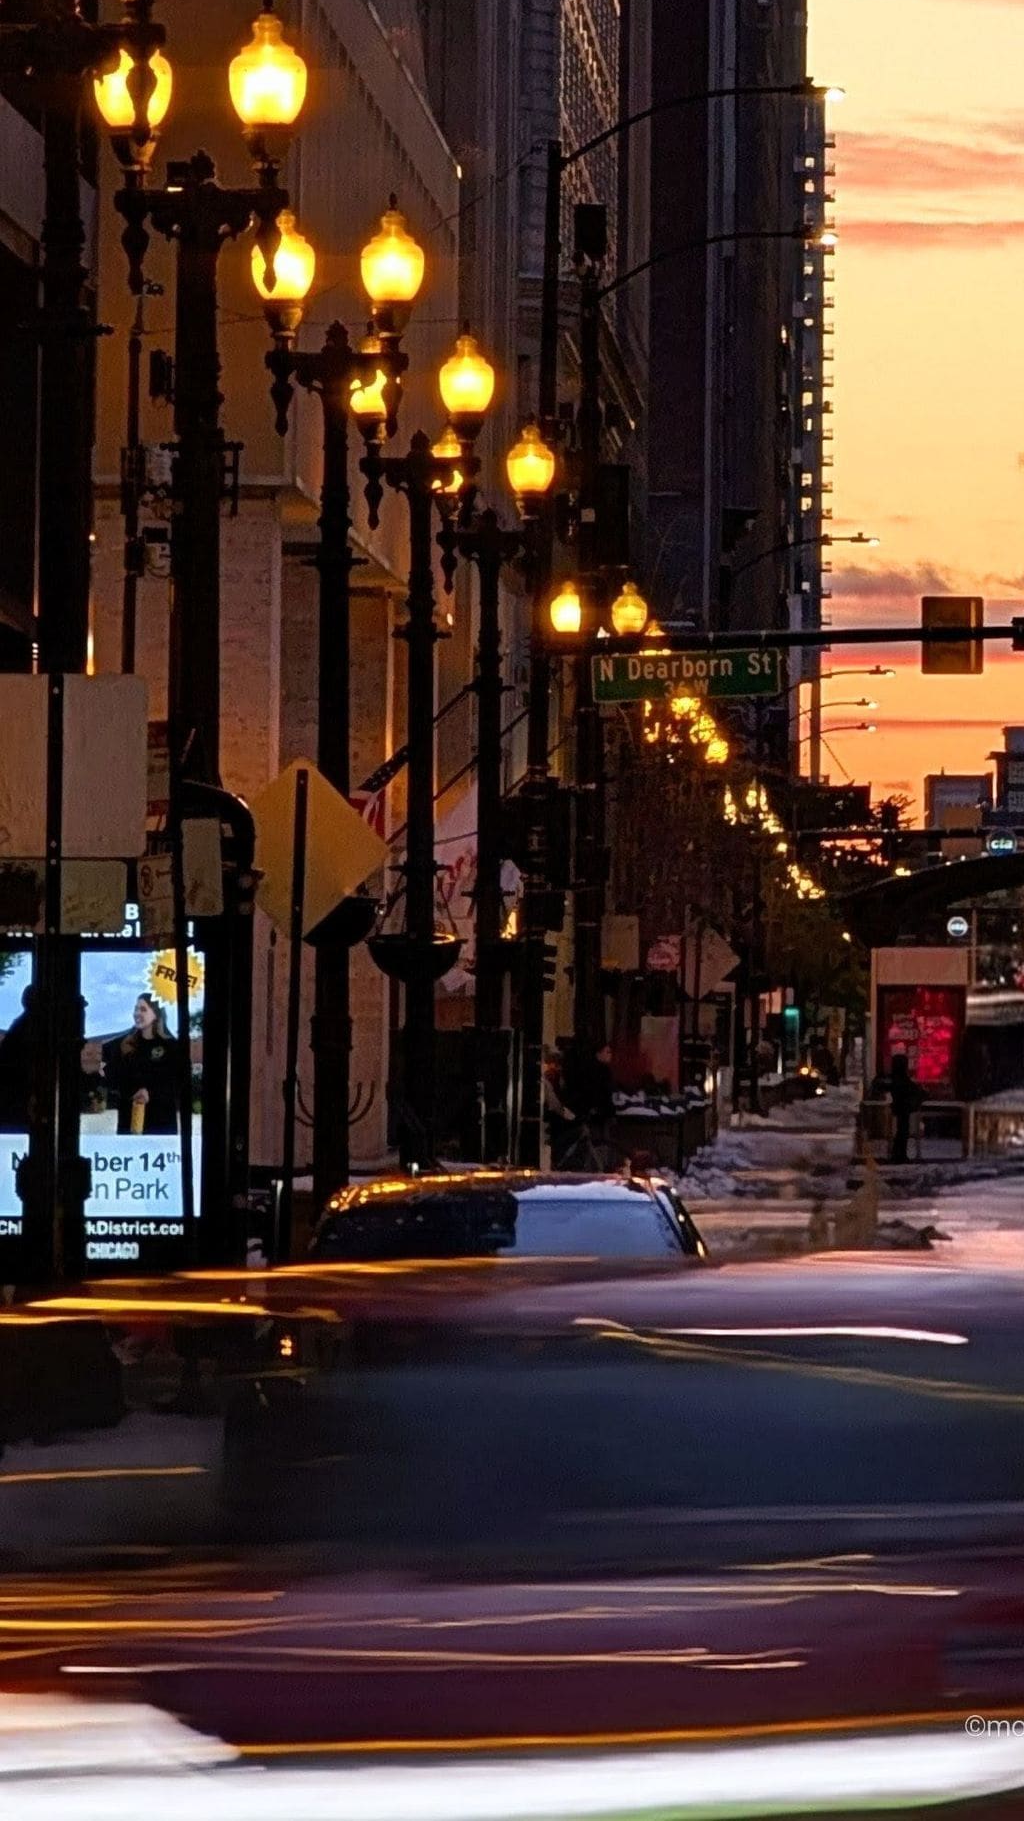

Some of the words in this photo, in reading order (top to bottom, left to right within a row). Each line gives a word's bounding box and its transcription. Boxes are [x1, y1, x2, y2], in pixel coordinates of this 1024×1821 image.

[600, 659, 613, 681] N
[628, 656, 733, 680] Dearborn
[747, 652, 771, 675] St
[115, 1178, 169, 1200] Park
[86, 1241, 139, 1260] CHICAGO
